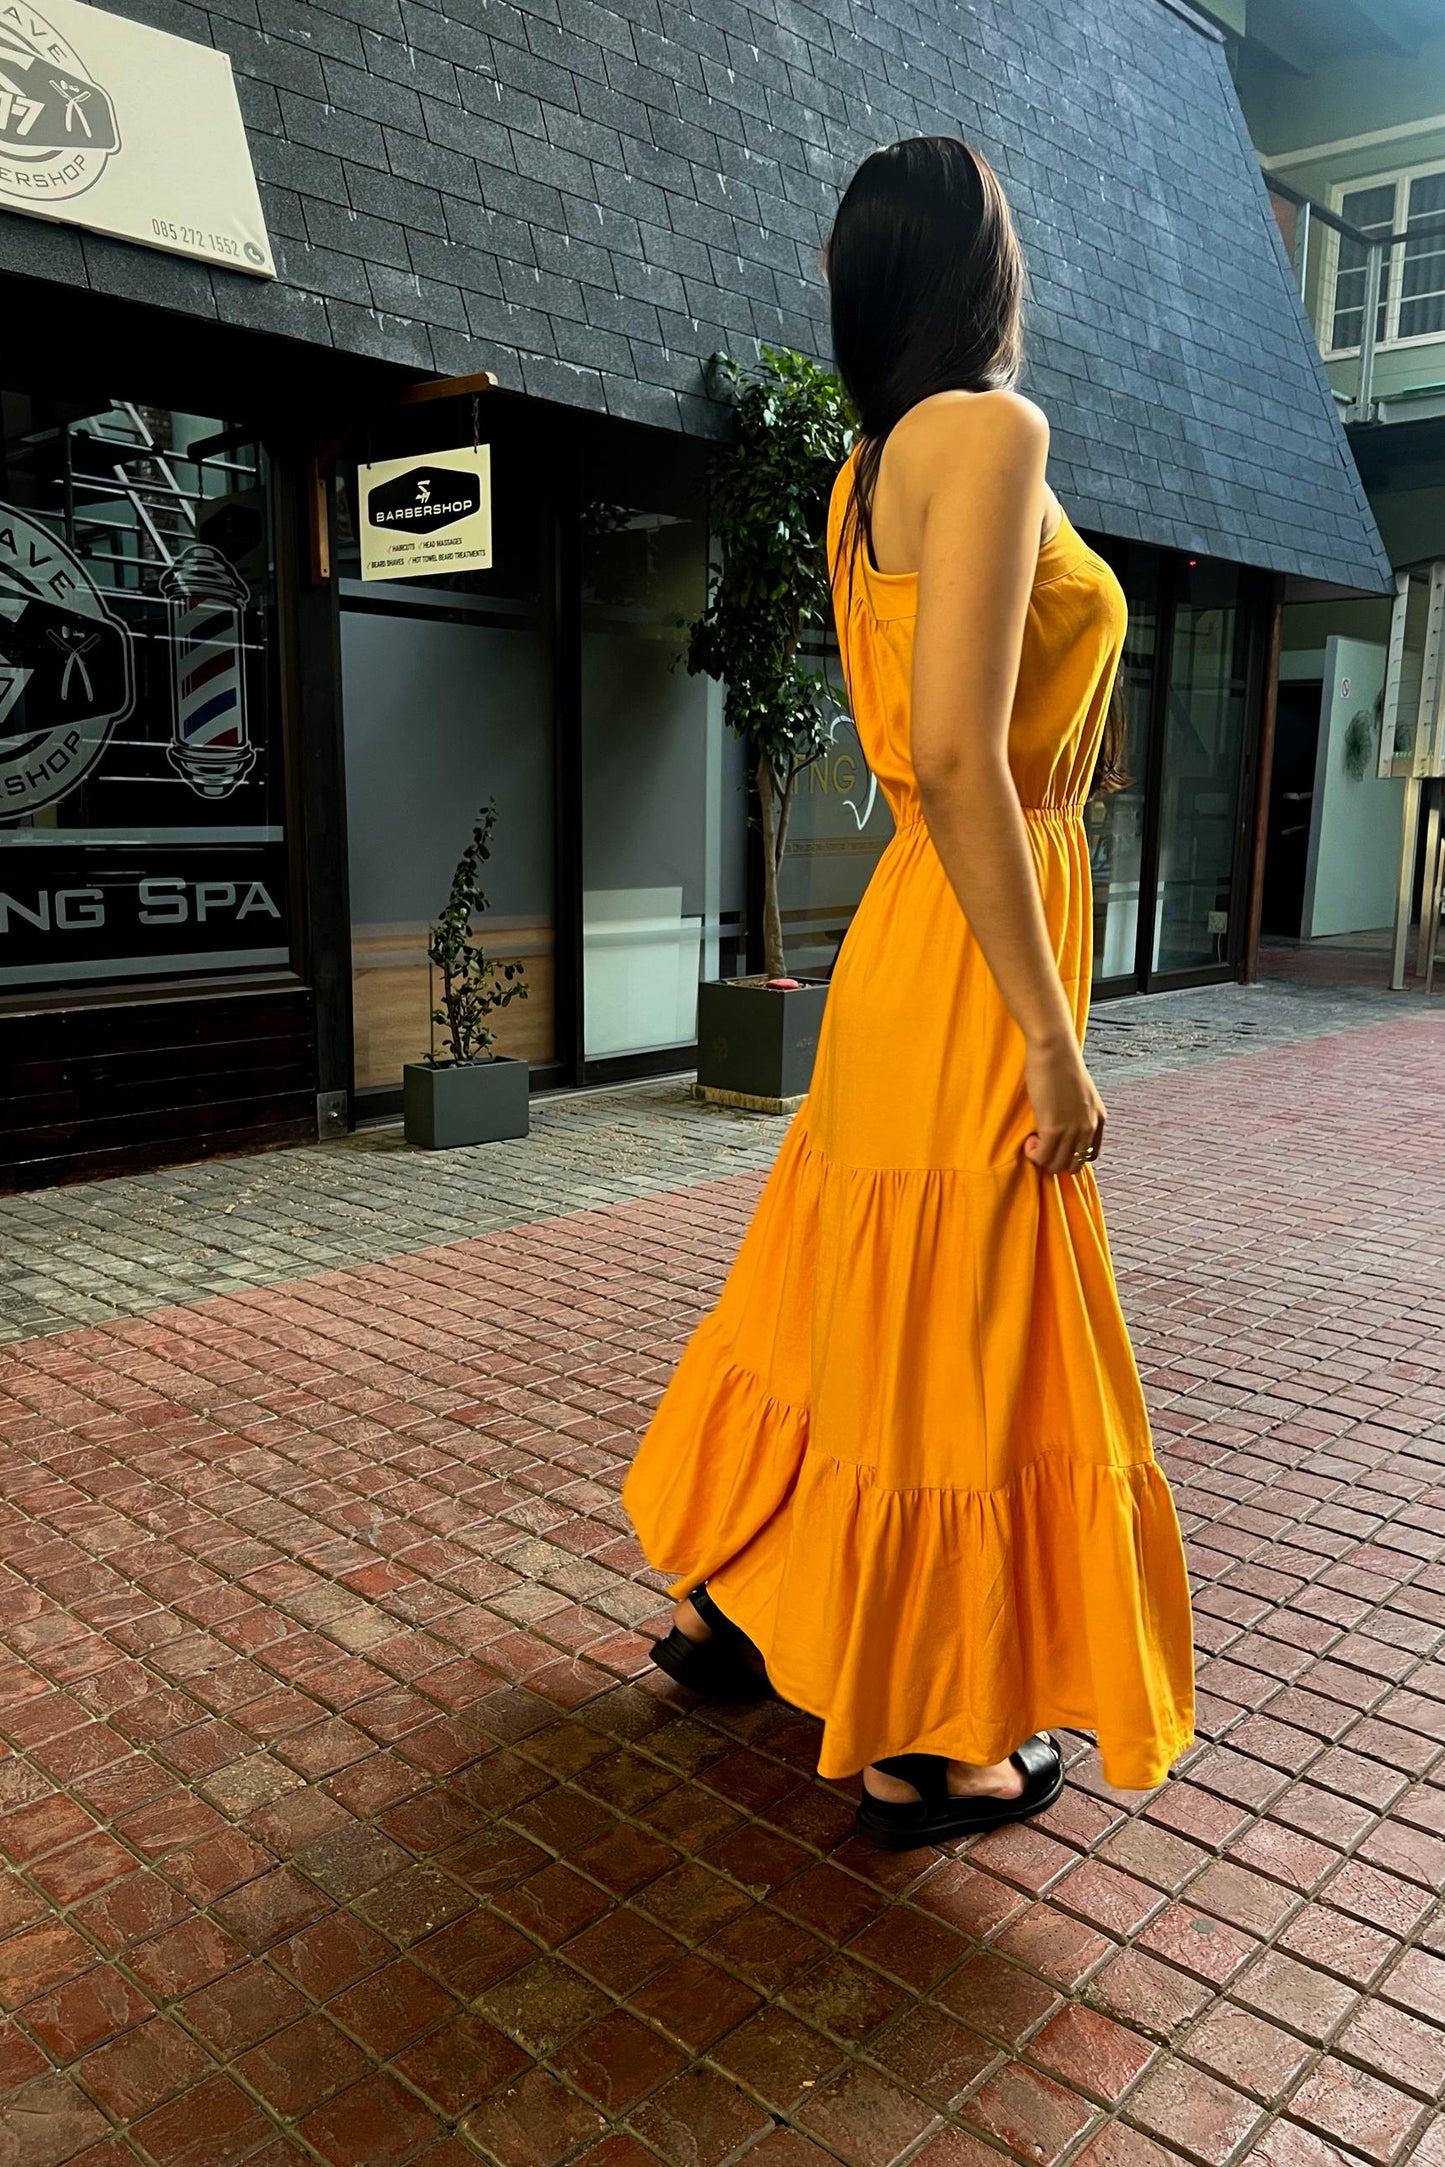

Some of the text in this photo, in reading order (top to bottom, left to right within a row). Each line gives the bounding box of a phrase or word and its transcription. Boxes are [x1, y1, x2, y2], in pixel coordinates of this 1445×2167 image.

[151, 218, 241, 258] 085 272 1552
[376, 499, 473, 523] BARBERSHOP
[0, 528, 75, 600] AVE
[371, 560, 386, 569] BEARD
[386, 558, 405, 567] SHAVES
[412, 556, 422, 564] HOT
[438, 552, 454, 561] BEARD
[454, 549, 486, 560] TREATMENTS
[392, 537, 462, 552] HAIRCUTS HEAD MASSAGES
[0, 730, 80, 797] SHOP
[0, 876, 282, 934] NG SPA
